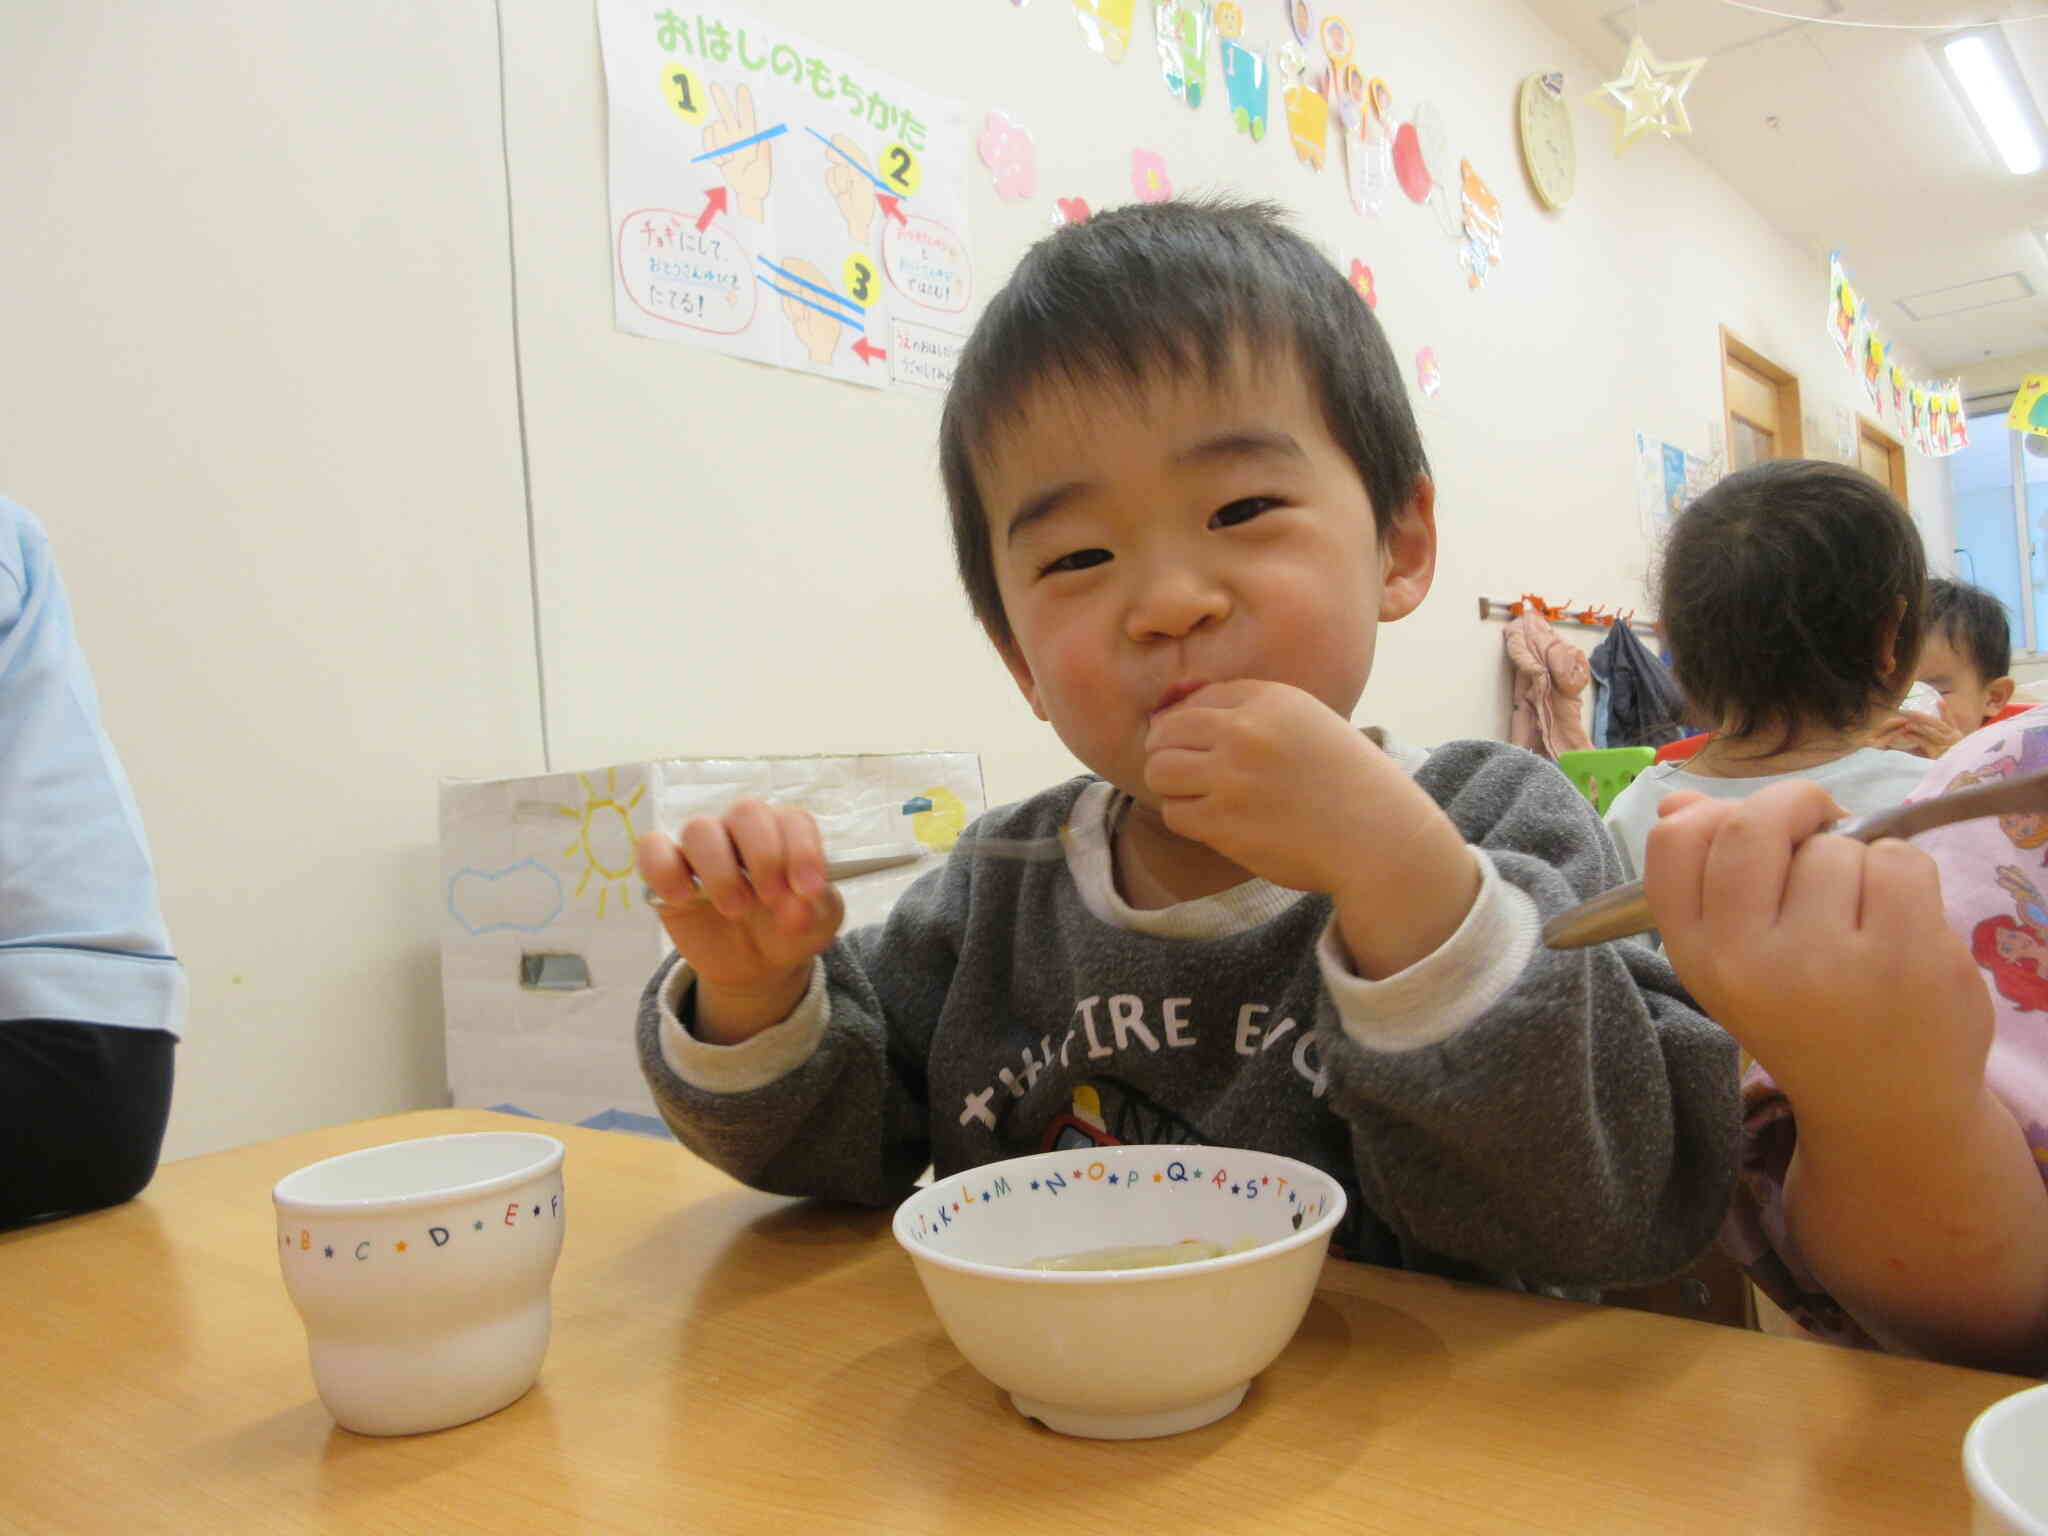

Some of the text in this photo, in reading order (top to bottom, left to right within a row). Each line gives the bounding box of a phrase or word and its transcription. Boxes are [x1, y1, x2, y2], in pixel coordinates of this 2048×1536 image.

[653, 8, 928, 152] おはしのもちかた
[672, 73, 698, 113] 1
[889, 147, 911, 187] 2
[852, 262, 872, 301] 3
[938, 1204, 952, 1227] K
[962, 1184, 976, 1204] L
[993, 1175, 1012, 1199] M
[1046, 1172, 1067, 1196] N
[1088, 1162, 1105, 1181] O
[1127, 1169, 1139, 1189] P
[1167, 1162, 1188, 1182] Q
[1211, 1169, 1227, 1190] R
[1246, 1179, 1258, 1199] S
[1276, 1176, 1289, 1198] T
[355, 1241, 370, 1260] C
[428, 1227, 450, 1247] D
[504, 1203, 519, 1226] E
[551, 1195, 558, 1217] F
